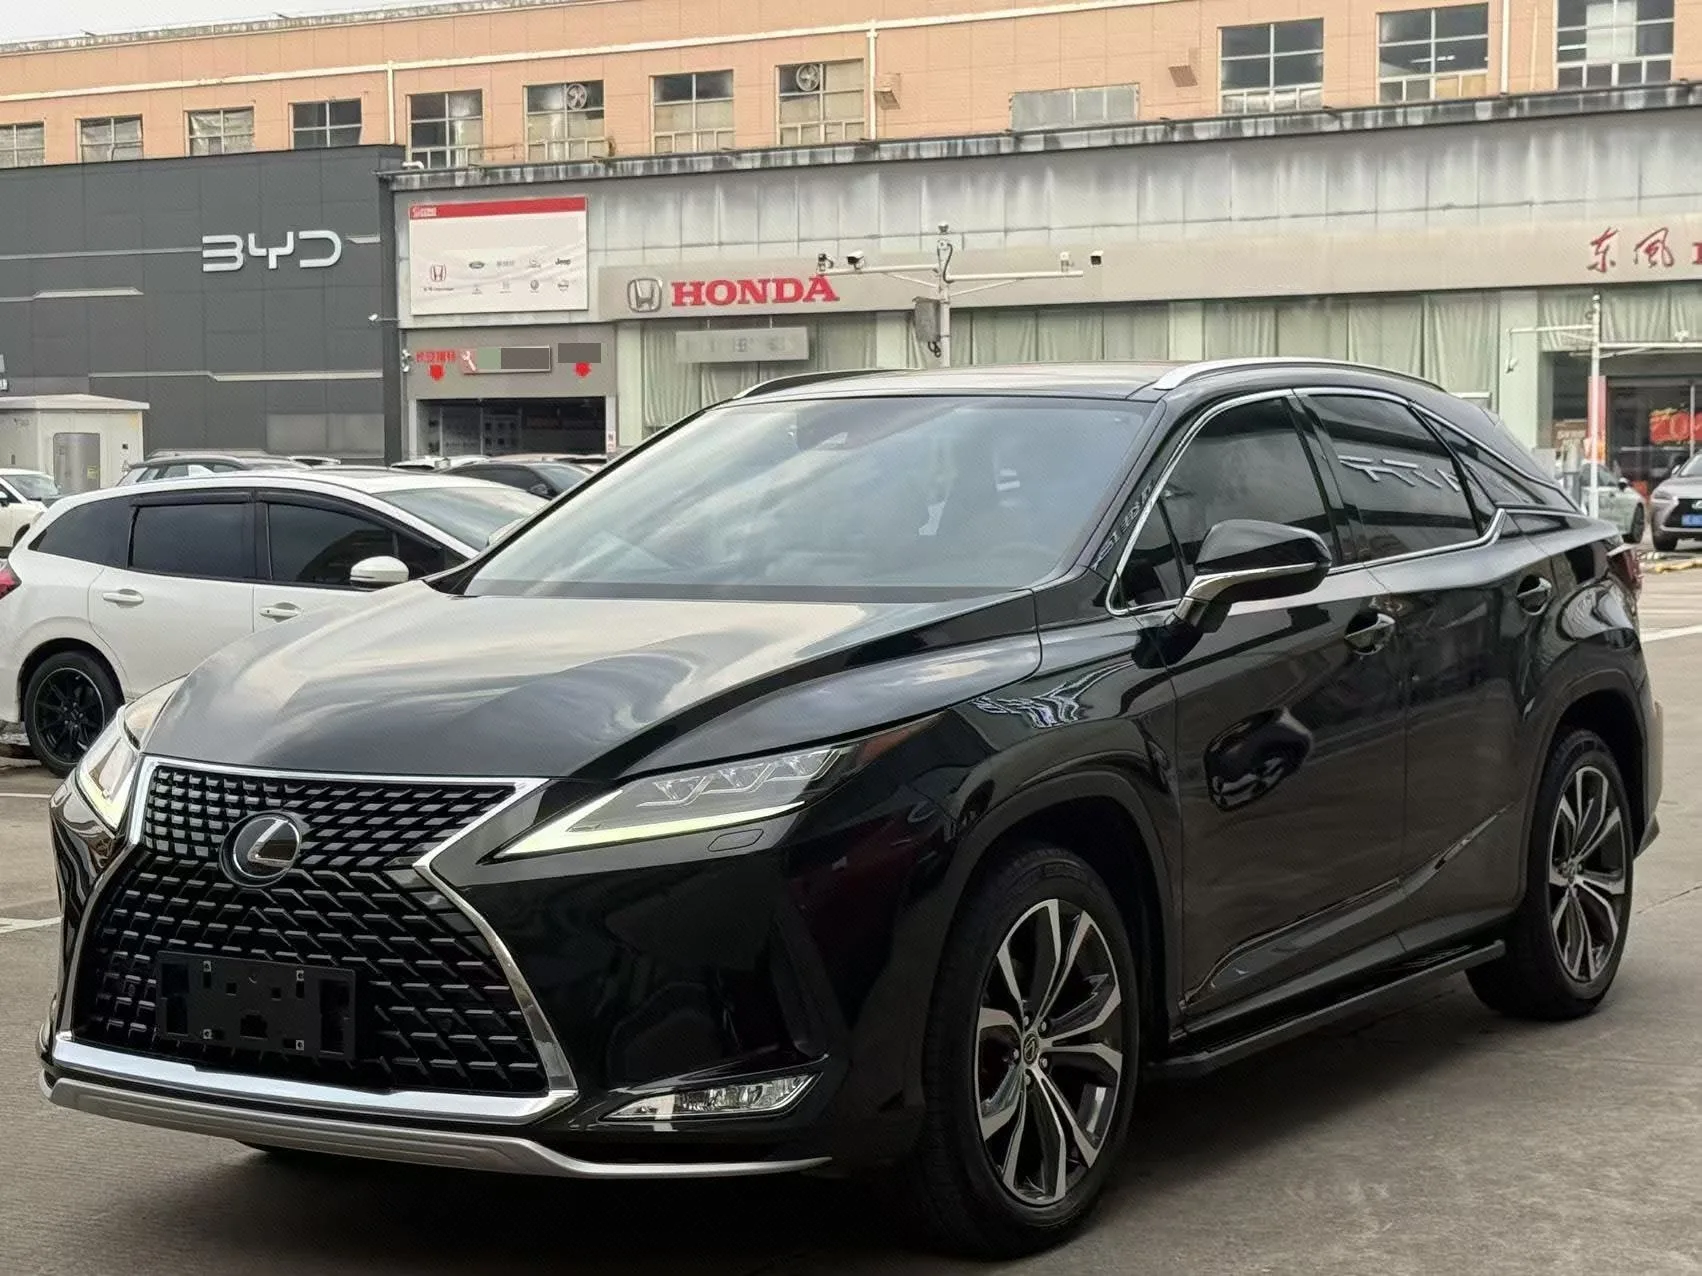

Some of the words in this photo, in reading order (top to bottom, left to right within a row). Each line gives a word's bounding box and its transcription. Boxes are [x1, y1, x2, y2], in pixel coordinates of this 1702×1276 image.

[202, 230, 342, 272] BYD
[1586, 226, 1675, 274] 东风
[671, 274, 840, 307] HONDA
